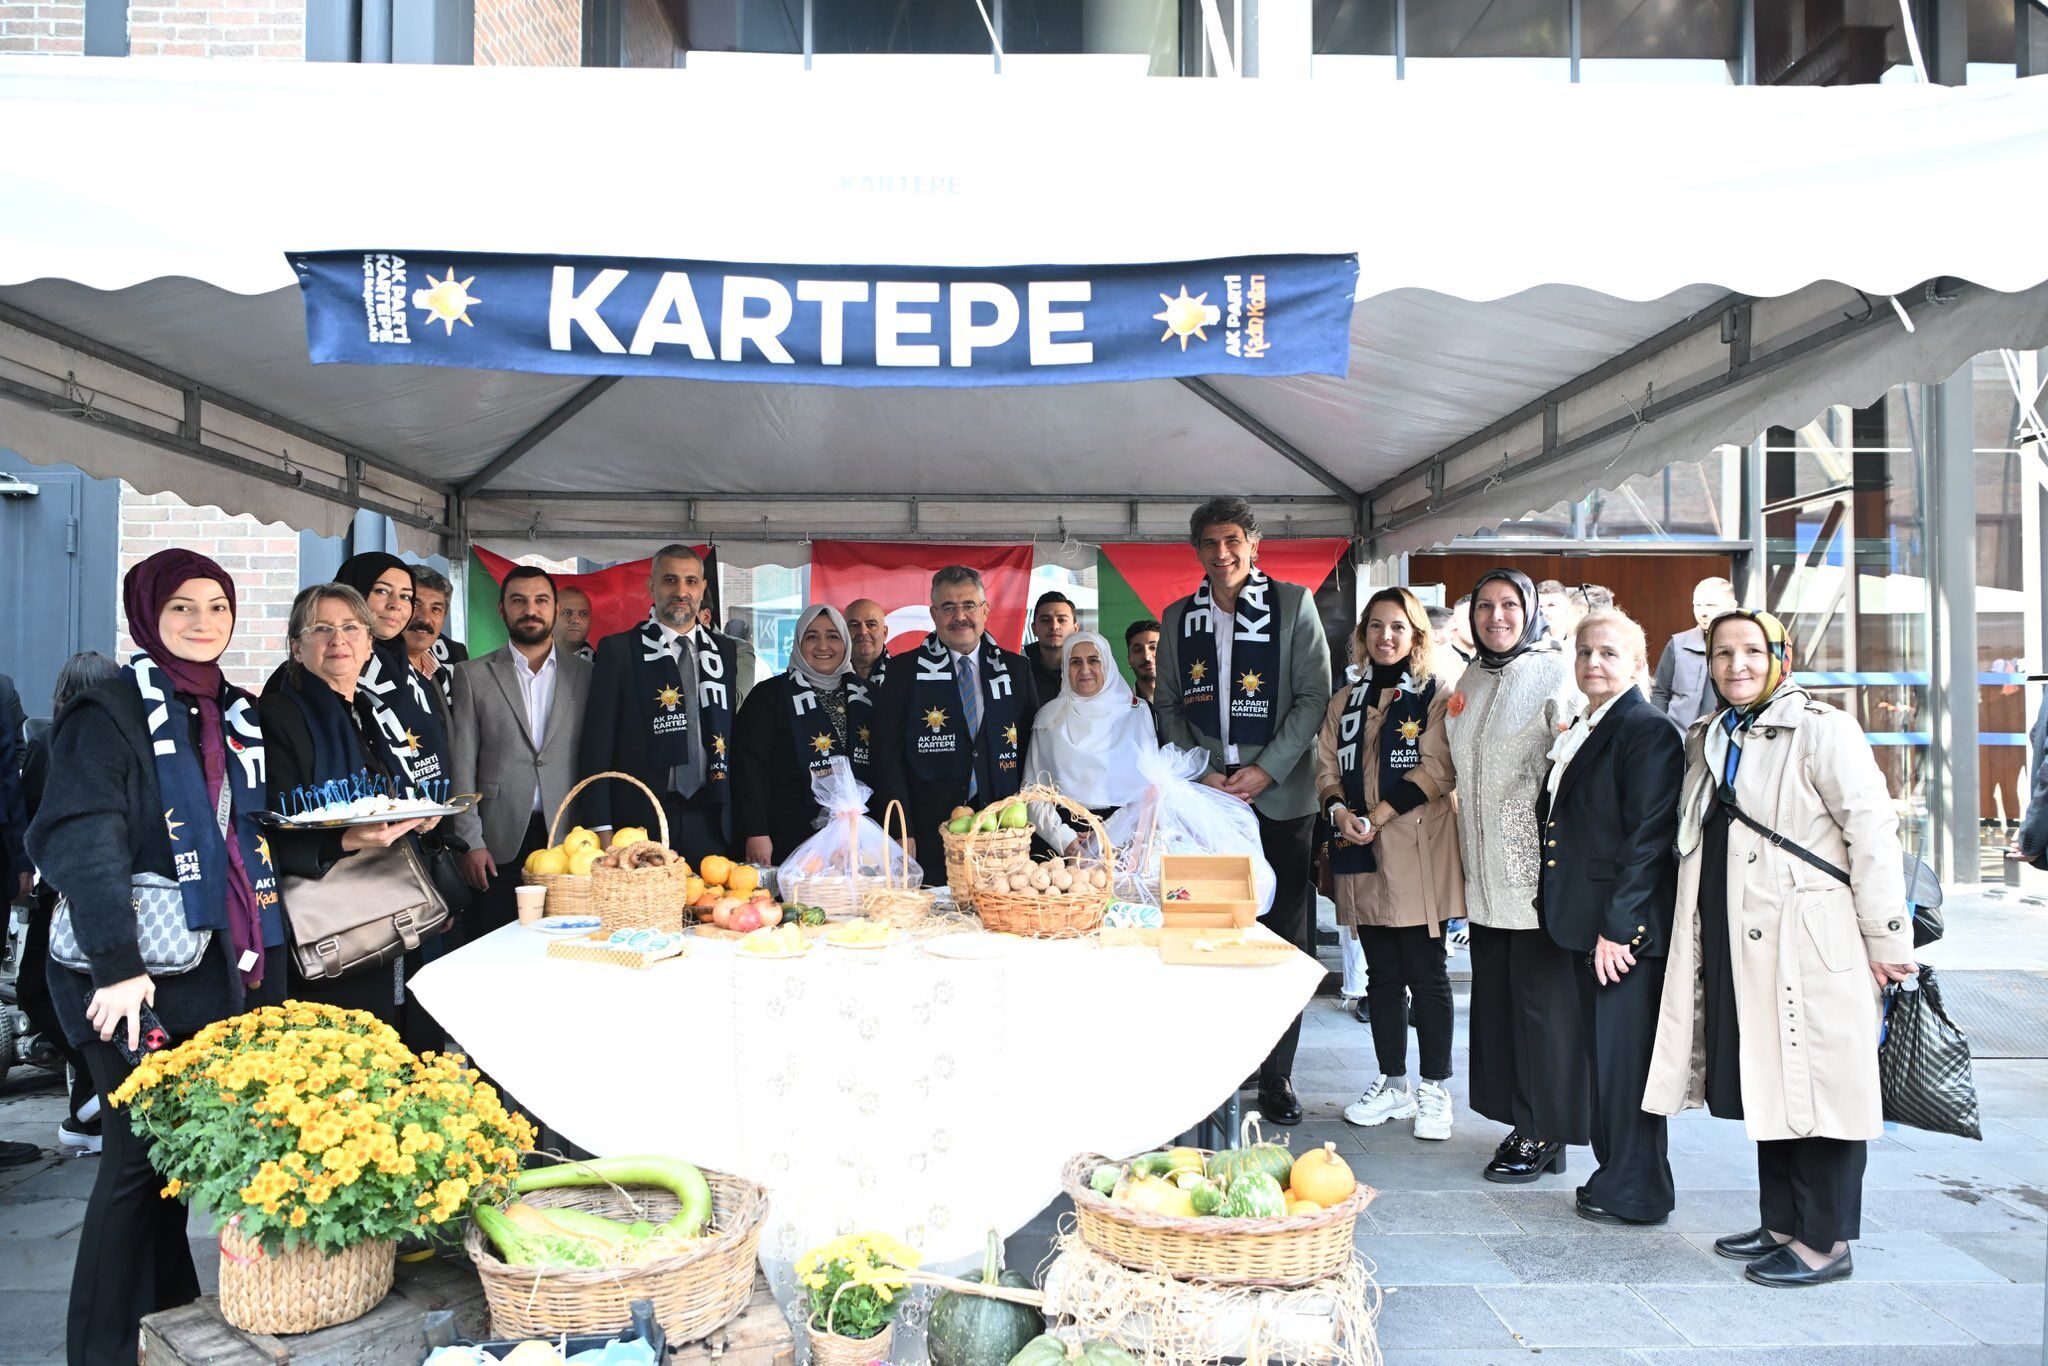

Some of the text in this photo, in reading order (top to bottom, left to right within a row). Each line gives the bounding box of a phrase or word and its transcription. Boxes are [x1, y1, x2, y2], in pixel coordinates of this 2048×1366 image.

[840, 175, 961, 195] KARTEPE
[391, 254, 407, 283] AK
[375, 253, 394, 343] KARTEPE
[549, 265, 1094, 367] KARTEPE
[1225, 330, 1241, 357] AK
[1231, 706, 1269, 714] KARTEPE
[653, 716, 665, 724] AK
[653, 719, 688, 730] KARTEP
[998, 752, 1011, 760] AK
[810, 760, 821, 768] AK
[255, 878, 271, 890] AK
